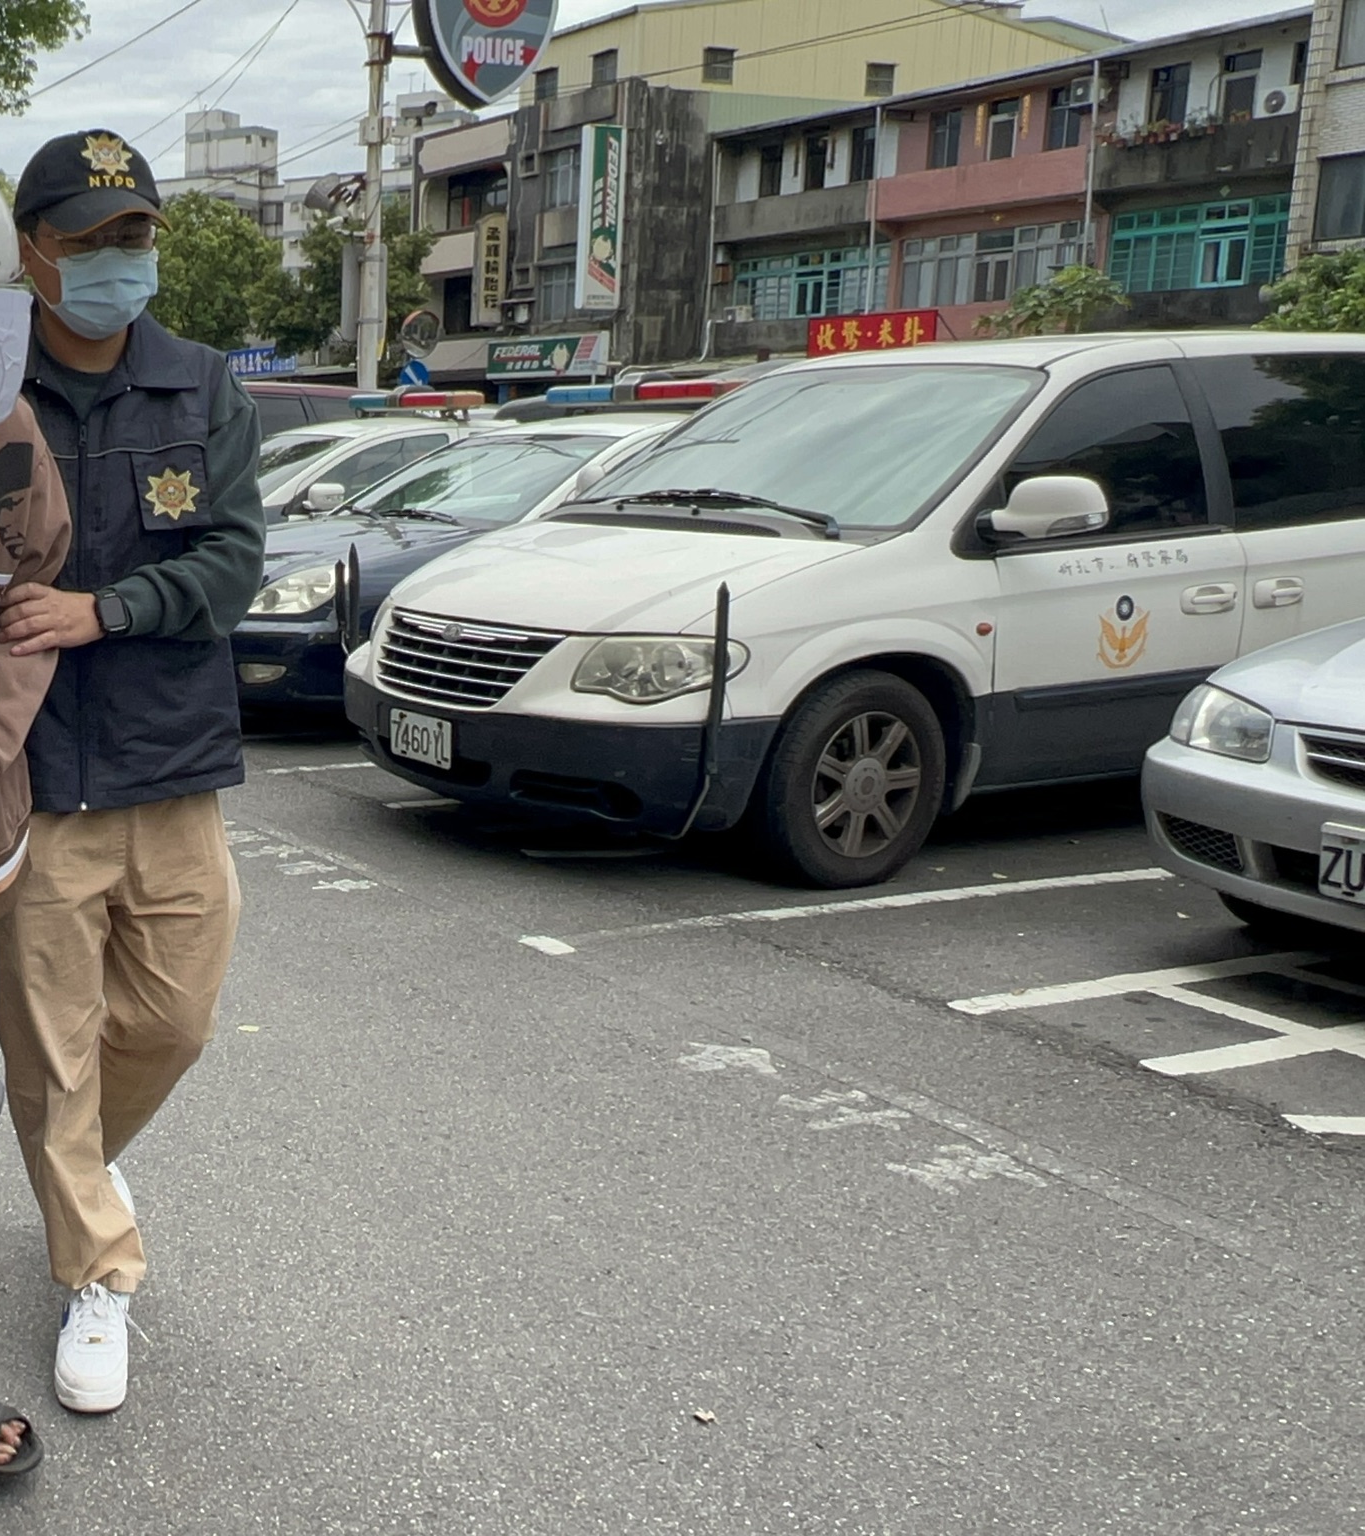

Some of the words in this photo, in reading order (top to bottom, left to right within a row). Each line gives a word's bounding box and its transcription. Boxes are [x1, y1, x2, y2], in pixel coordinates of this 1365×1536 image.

[461, 35, 525, 66] POLICE
[605, 136, 620, 228] FEDERAL
[494, 344, 541, 358] FEDERAL
[1058, 550, 1188, 577] 新北市府警察局
[1321, 845, 1365, 892] ZU
